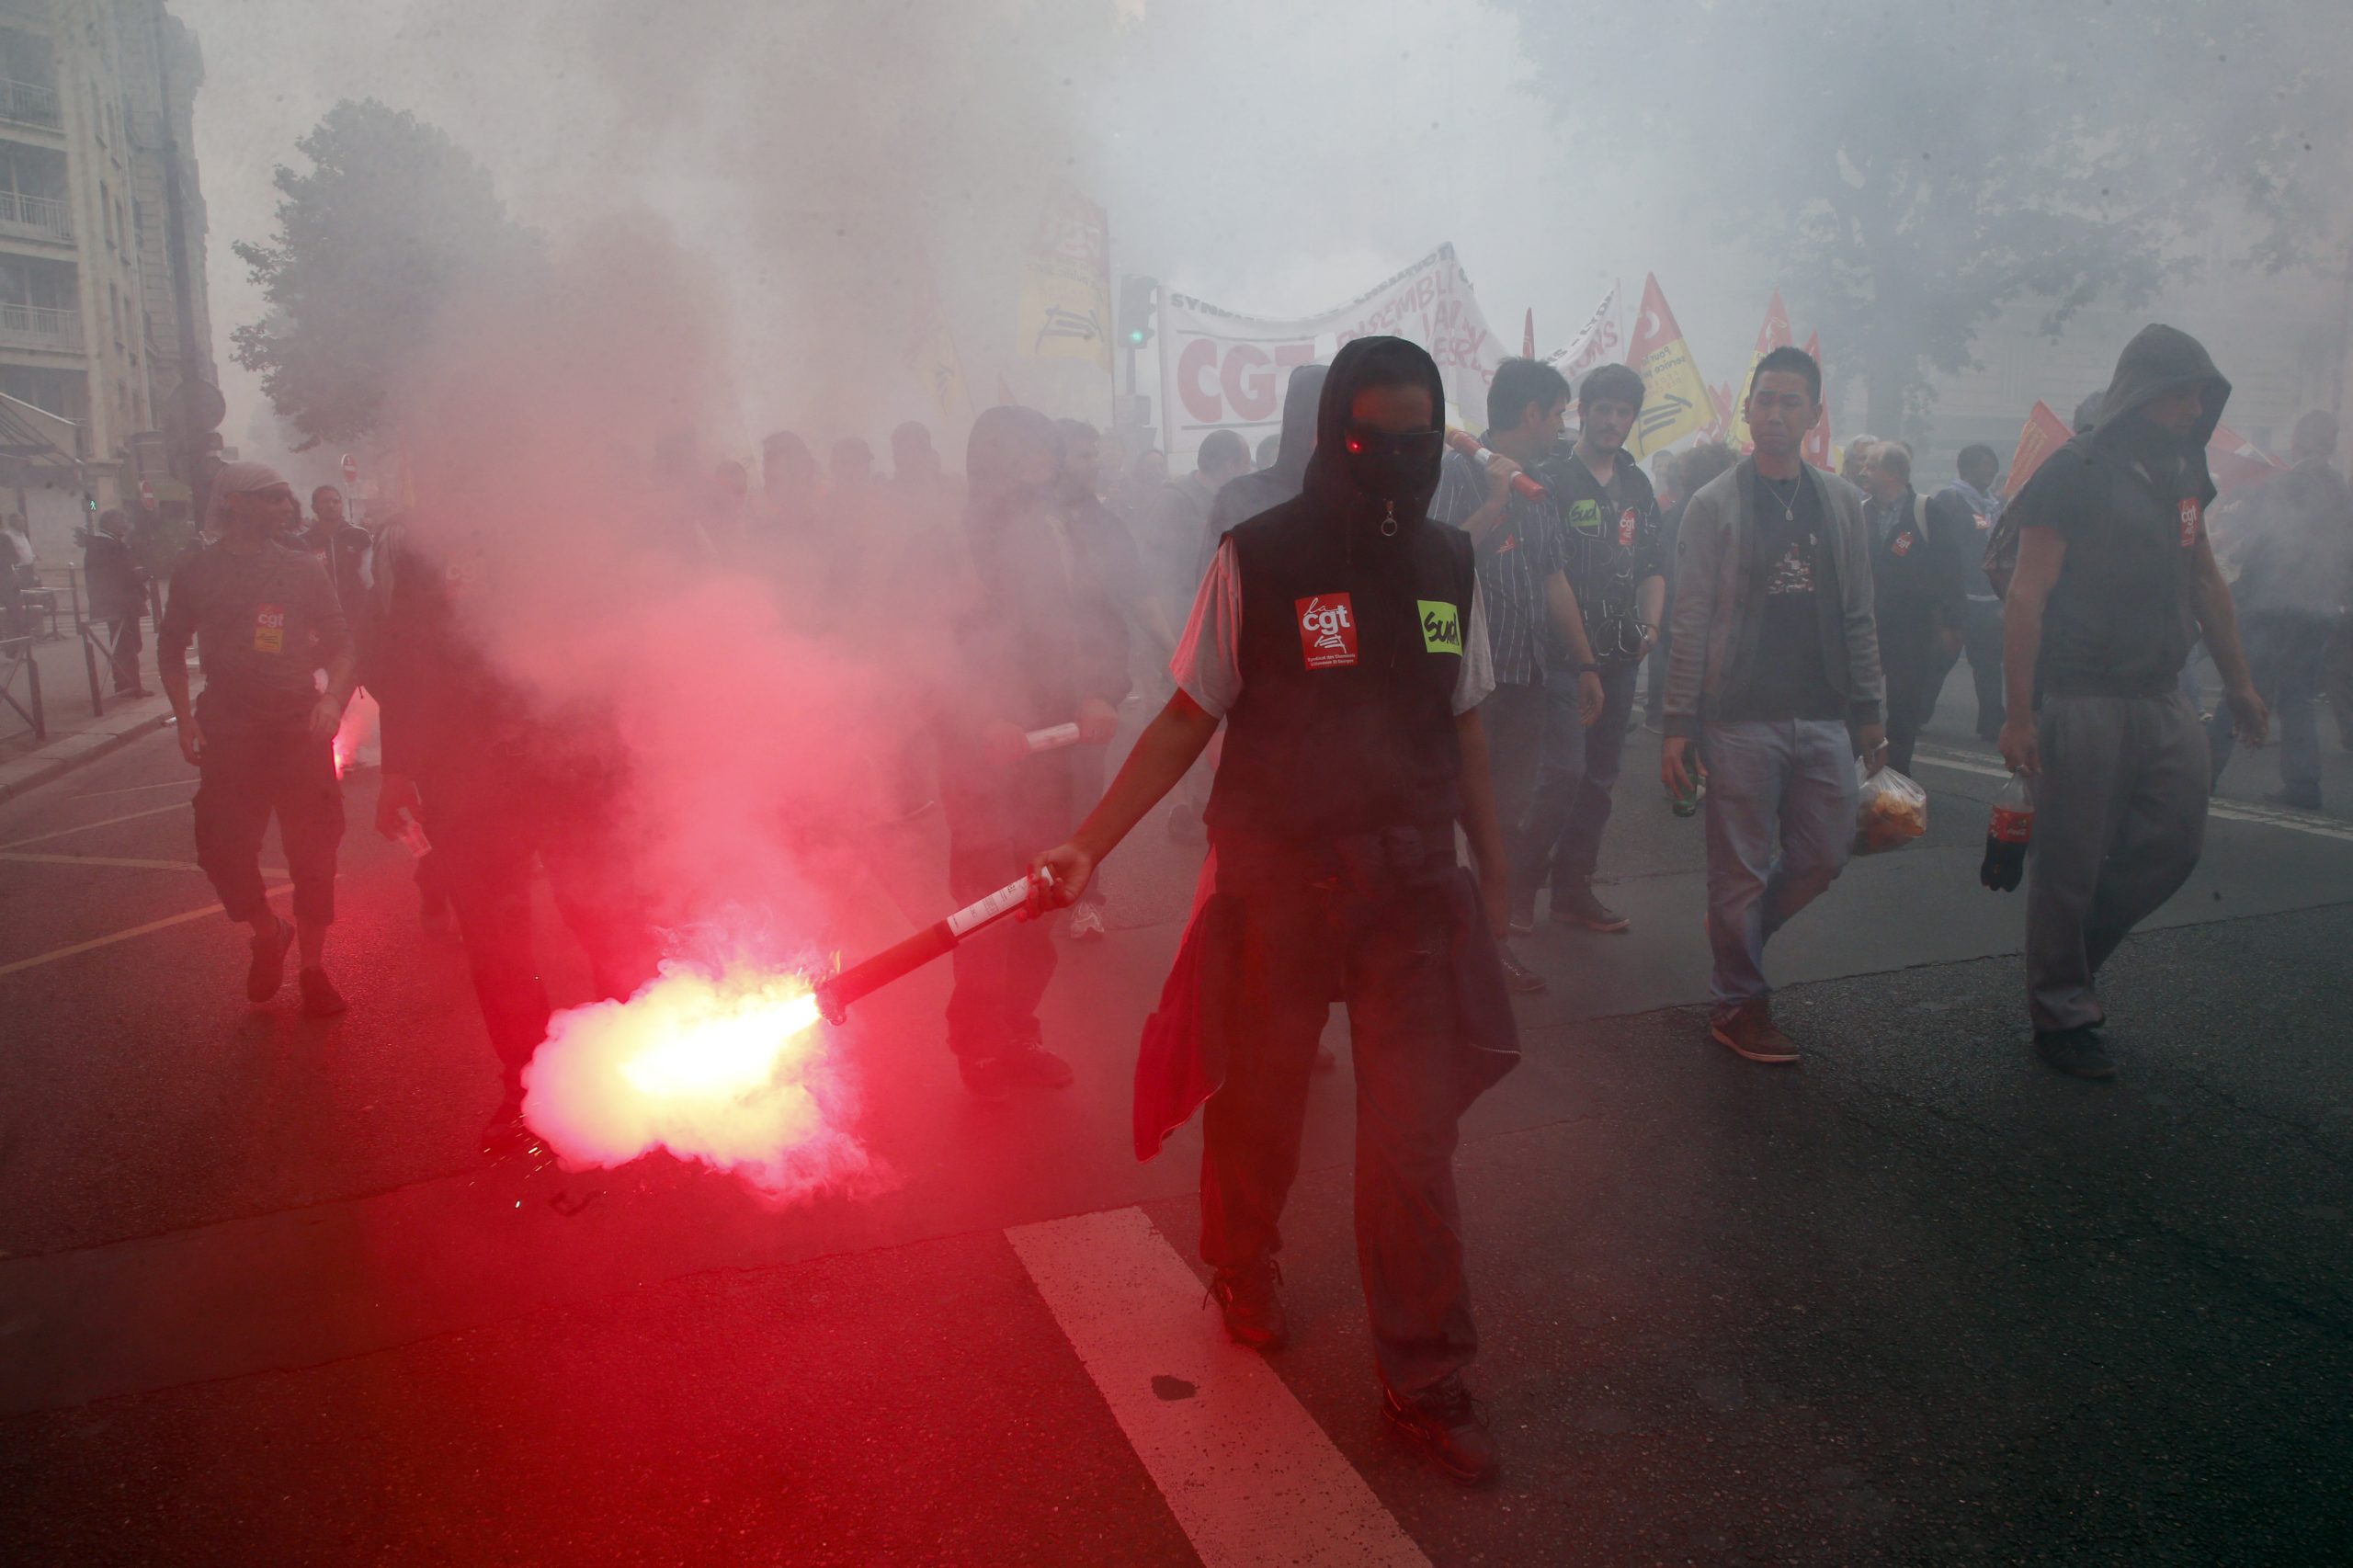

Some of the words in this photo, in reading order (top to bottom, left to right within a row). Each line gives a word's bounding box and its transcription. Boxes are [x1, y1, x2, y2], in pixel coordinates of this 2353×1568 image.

[1620, 517, 1635, 532] cgt
[2181, 506, 2197, 527] cgt
[258, 613, 284, 628] cgt
[1302, 605, 1351, 635] cgt
